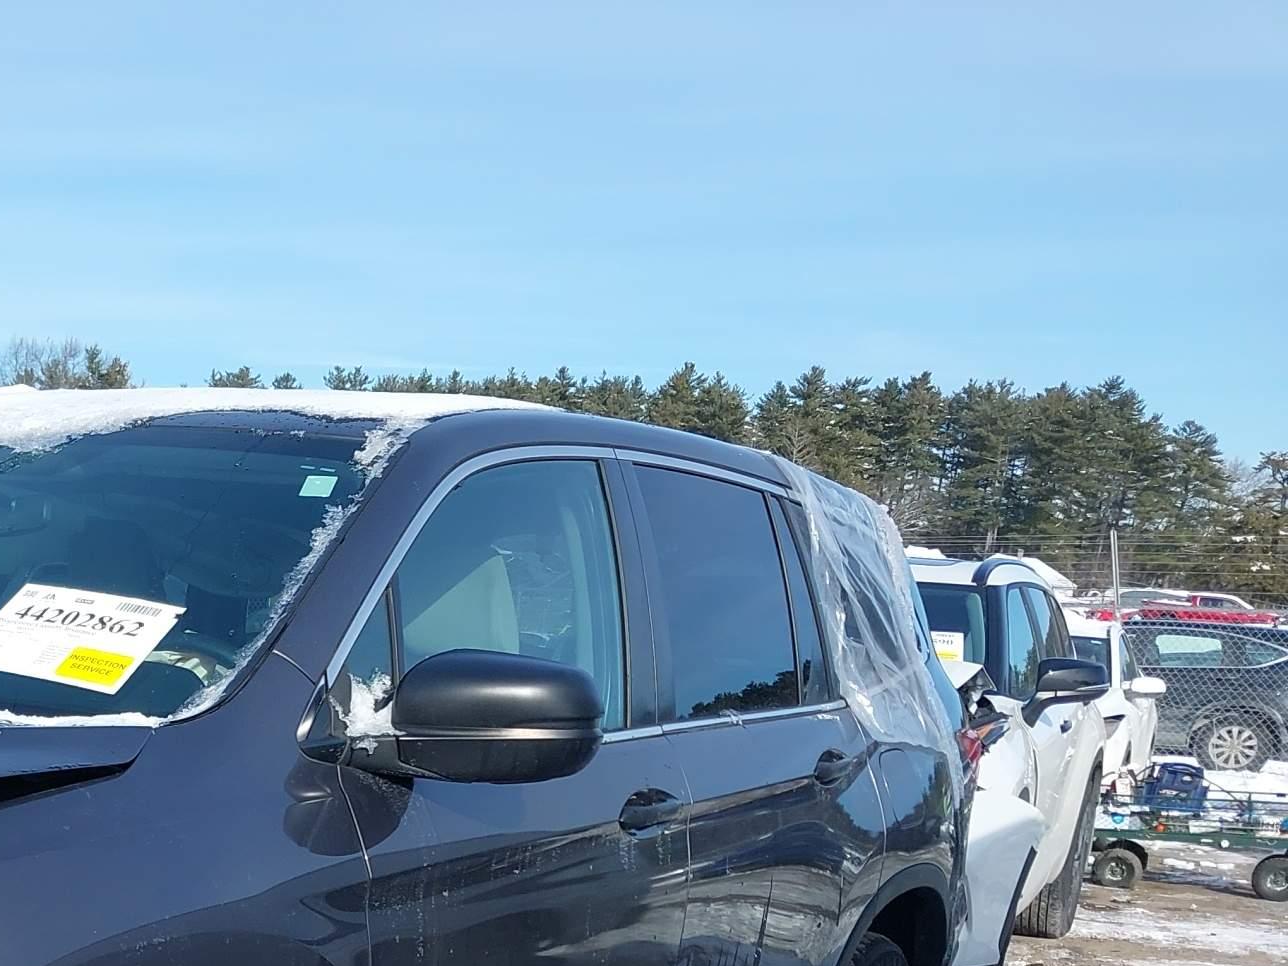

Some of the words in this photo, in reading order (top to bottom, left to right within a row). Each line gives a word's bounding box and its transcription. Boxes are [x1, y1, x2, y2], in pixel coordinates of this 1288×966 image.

[15, 604, 145, 637] 44202862
[70, 654, 127, 670] INSPECTION
[70, 662, 114, 677] SERVICE
